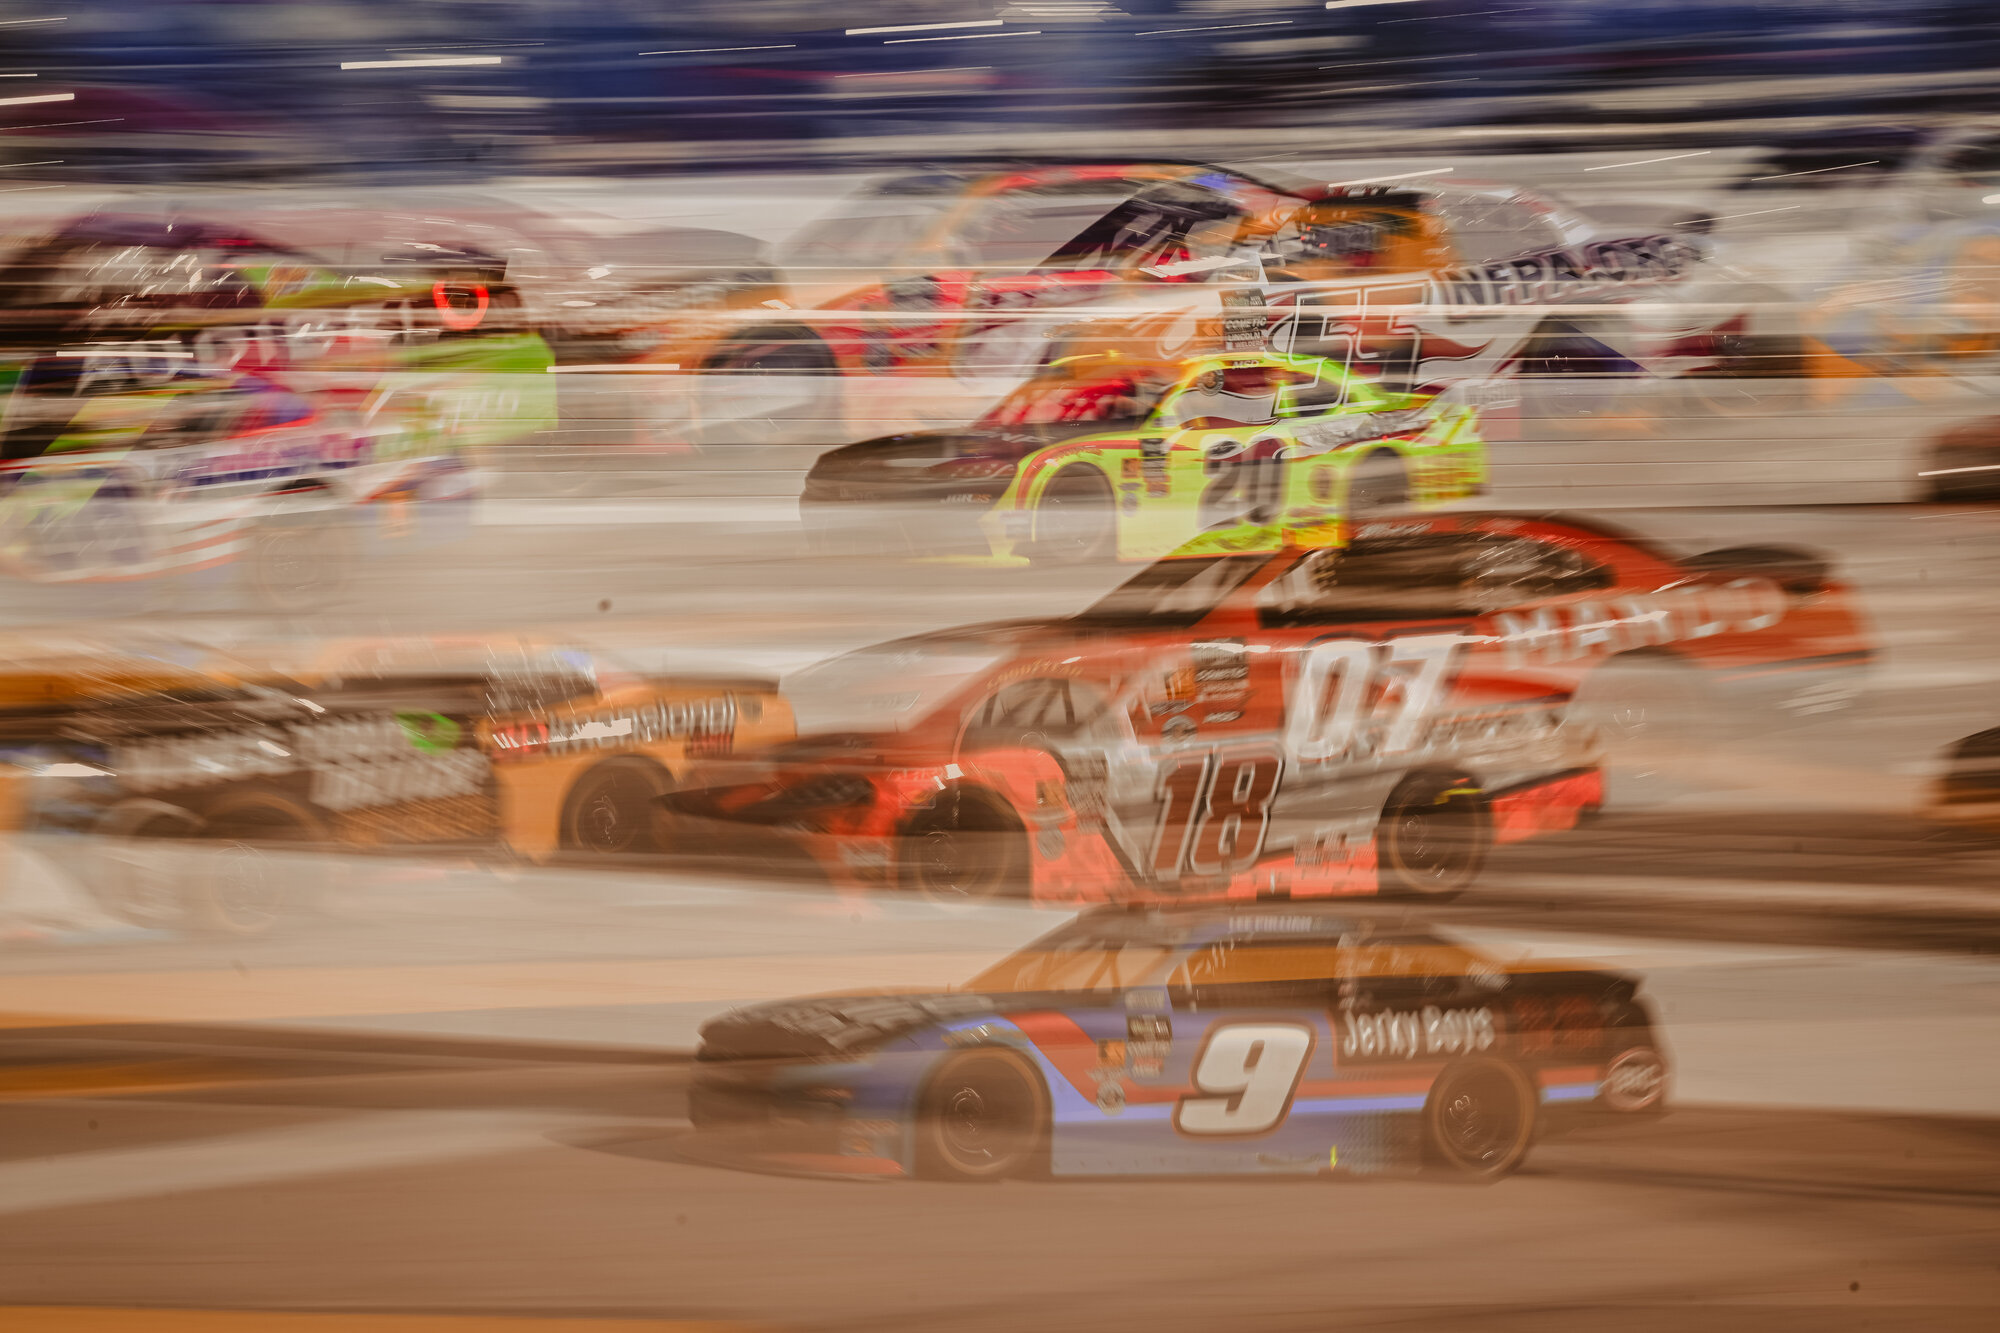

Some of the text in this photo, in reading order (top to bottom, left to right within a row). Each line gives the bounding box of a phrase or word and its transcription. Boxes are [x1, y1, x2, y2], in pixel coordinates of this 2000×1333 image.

[1227, 332, 1262, 341] LINCOLN
[1234, 340, 1264, 348] WELDERS
[1233, 360, 1259, 369] MSD
[1151, 755, 1284, 881] 18
[1345, 1007, 1419, 1057] Jerky
[1177, 1023, 1313, 1133] 9
